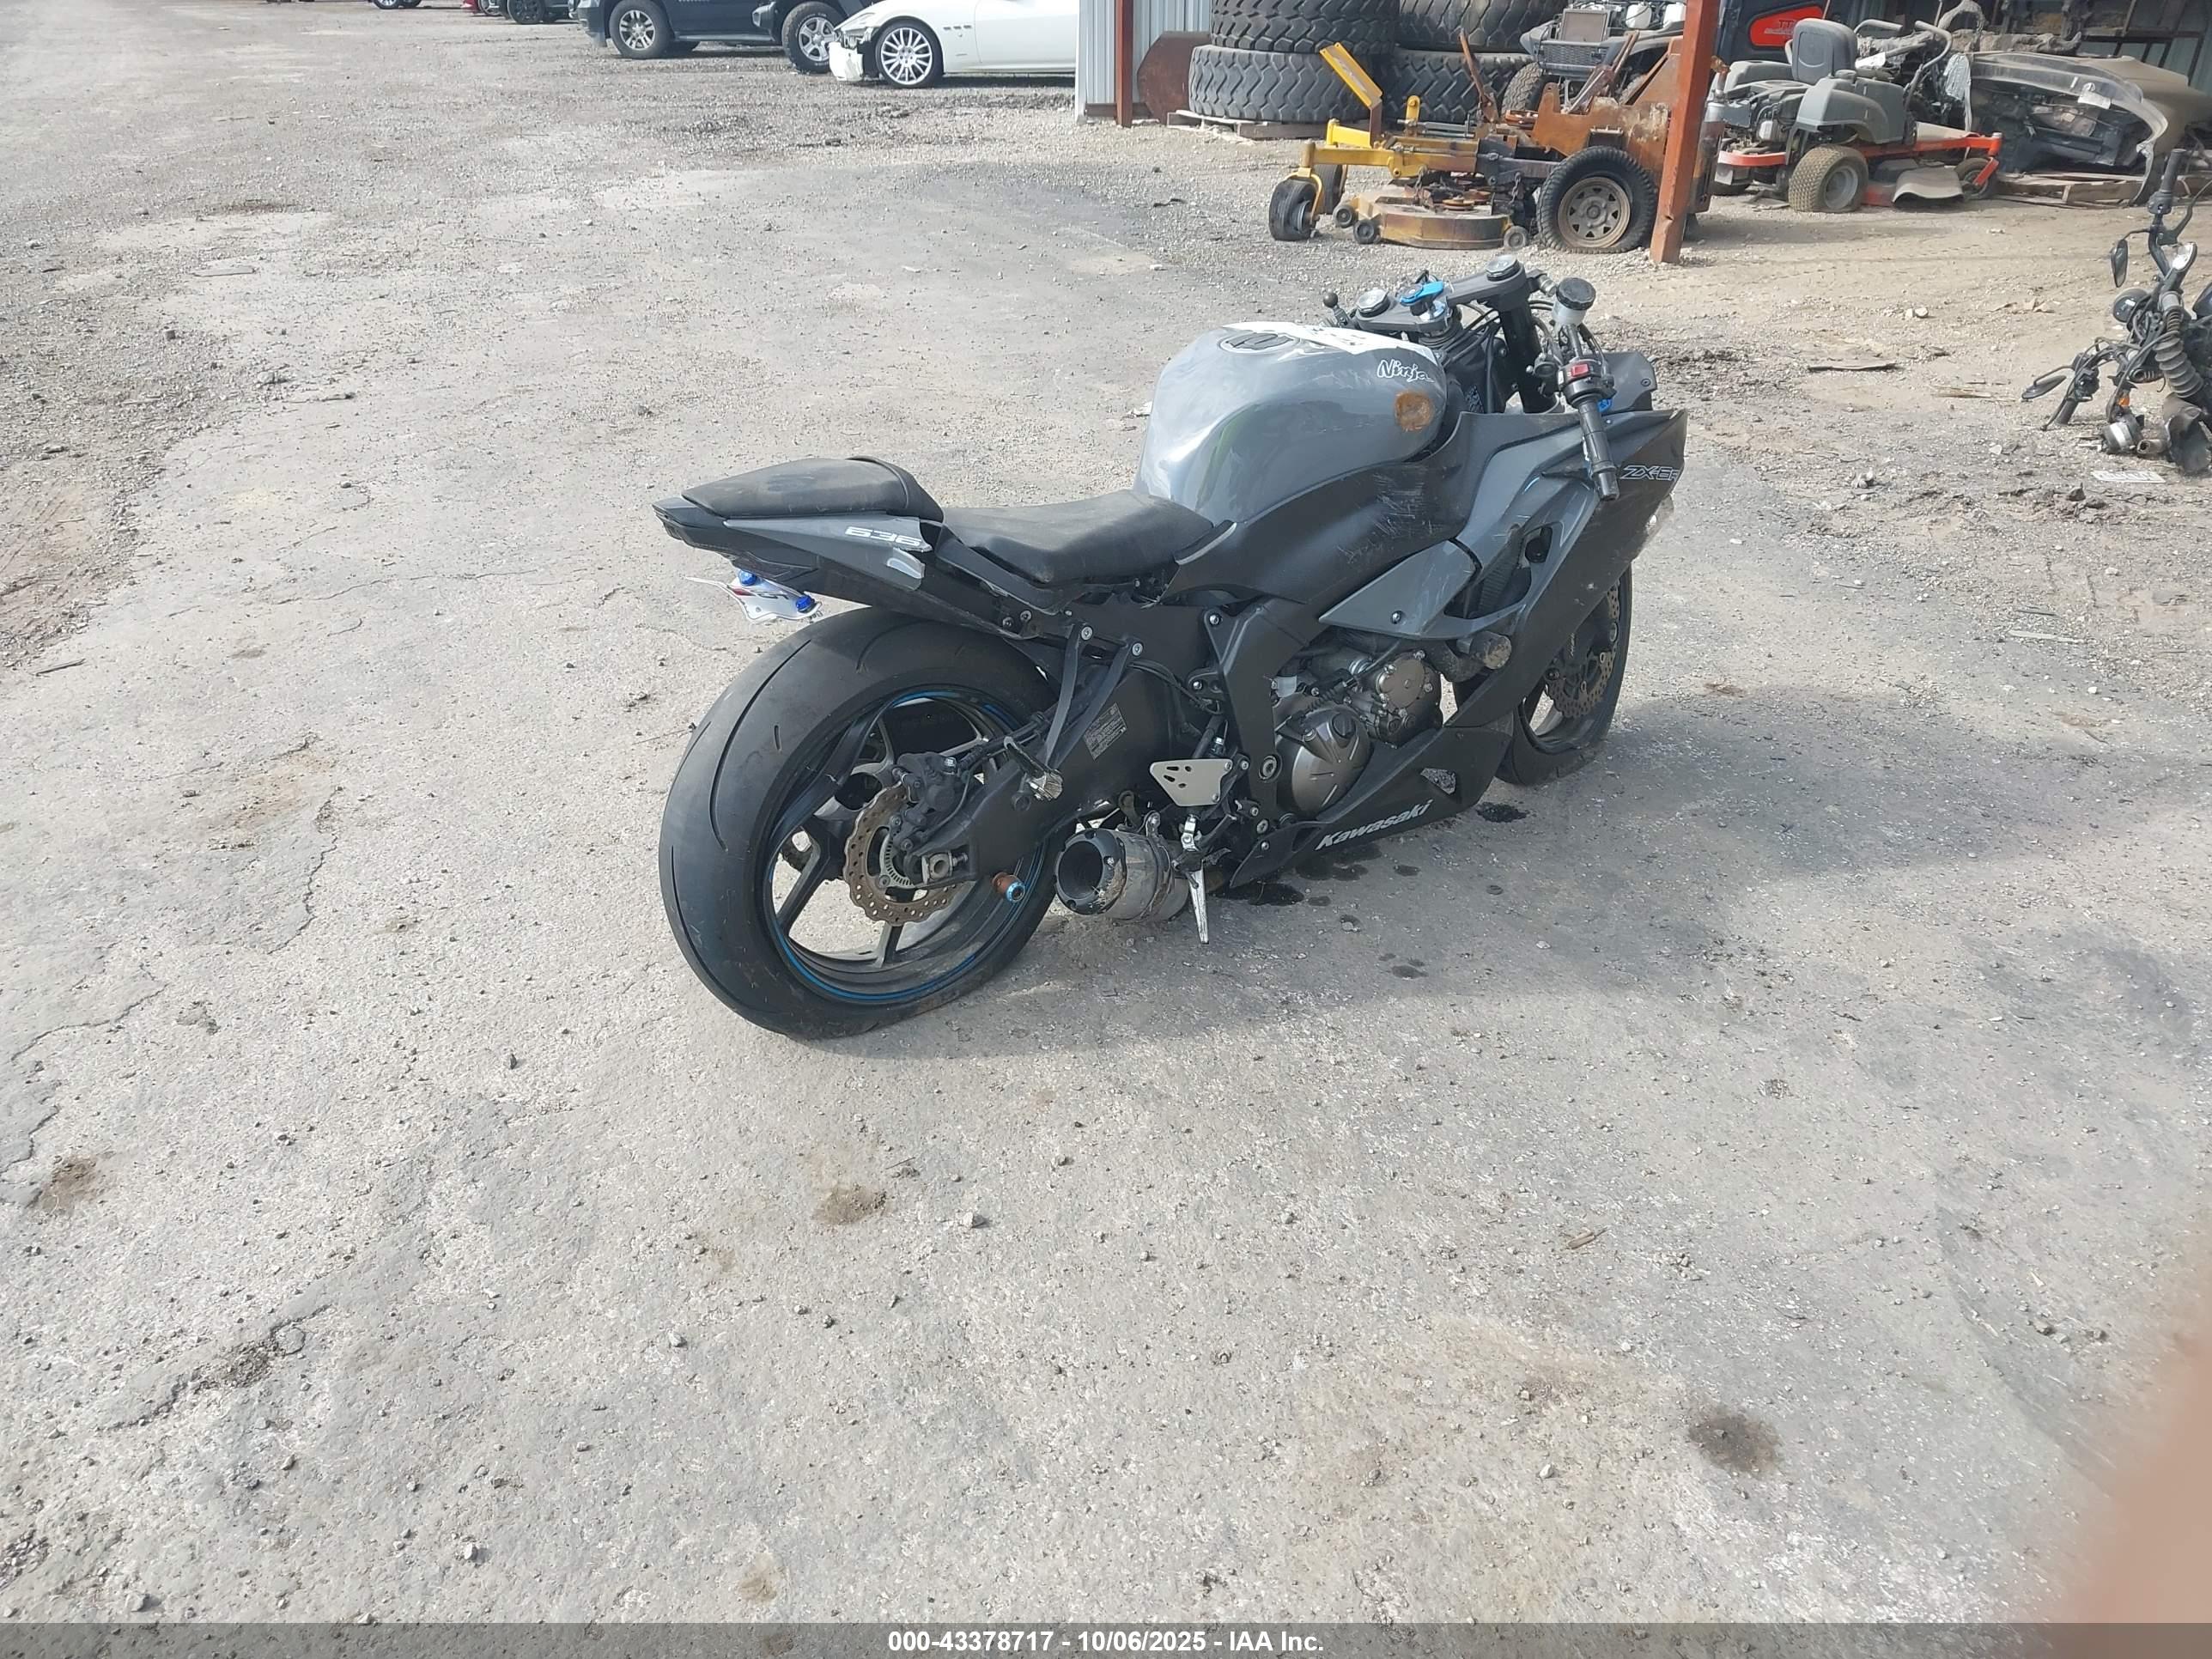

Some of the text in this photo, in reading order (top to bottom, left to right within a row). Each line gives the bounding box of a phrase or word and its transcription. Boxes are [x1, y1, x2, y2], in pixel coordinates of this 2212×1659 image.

[1376, 359, 1435, 383] Ninja
[844, 526, 922, 546] 636
[1315, 799, 1433, 851] Kawasaki
